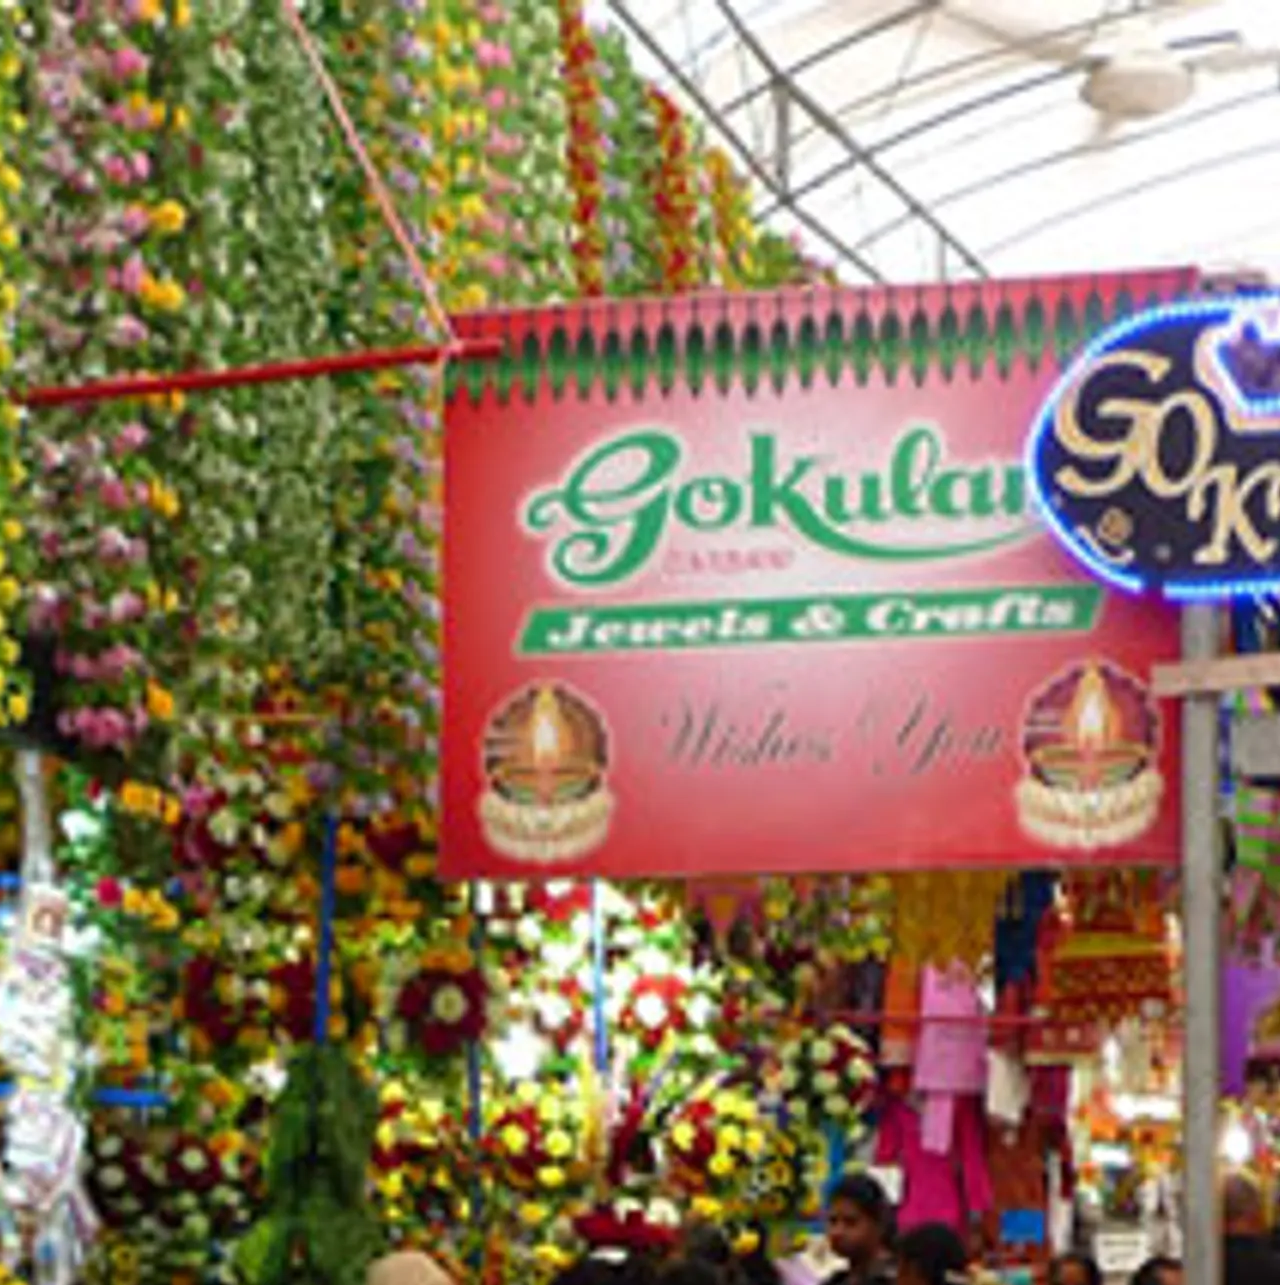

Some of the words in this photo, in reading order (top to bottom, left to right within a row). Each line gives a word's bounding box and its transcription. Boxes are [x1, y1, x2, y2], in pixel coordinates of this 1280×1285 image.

[546, 605, 771, 650] Jewels
[790, 600, 846, 637] &
[866, 589, 1077, 632] Crafts
[656, 686, 837, 769] Wishes
[854, 692, 1006, 777] You
